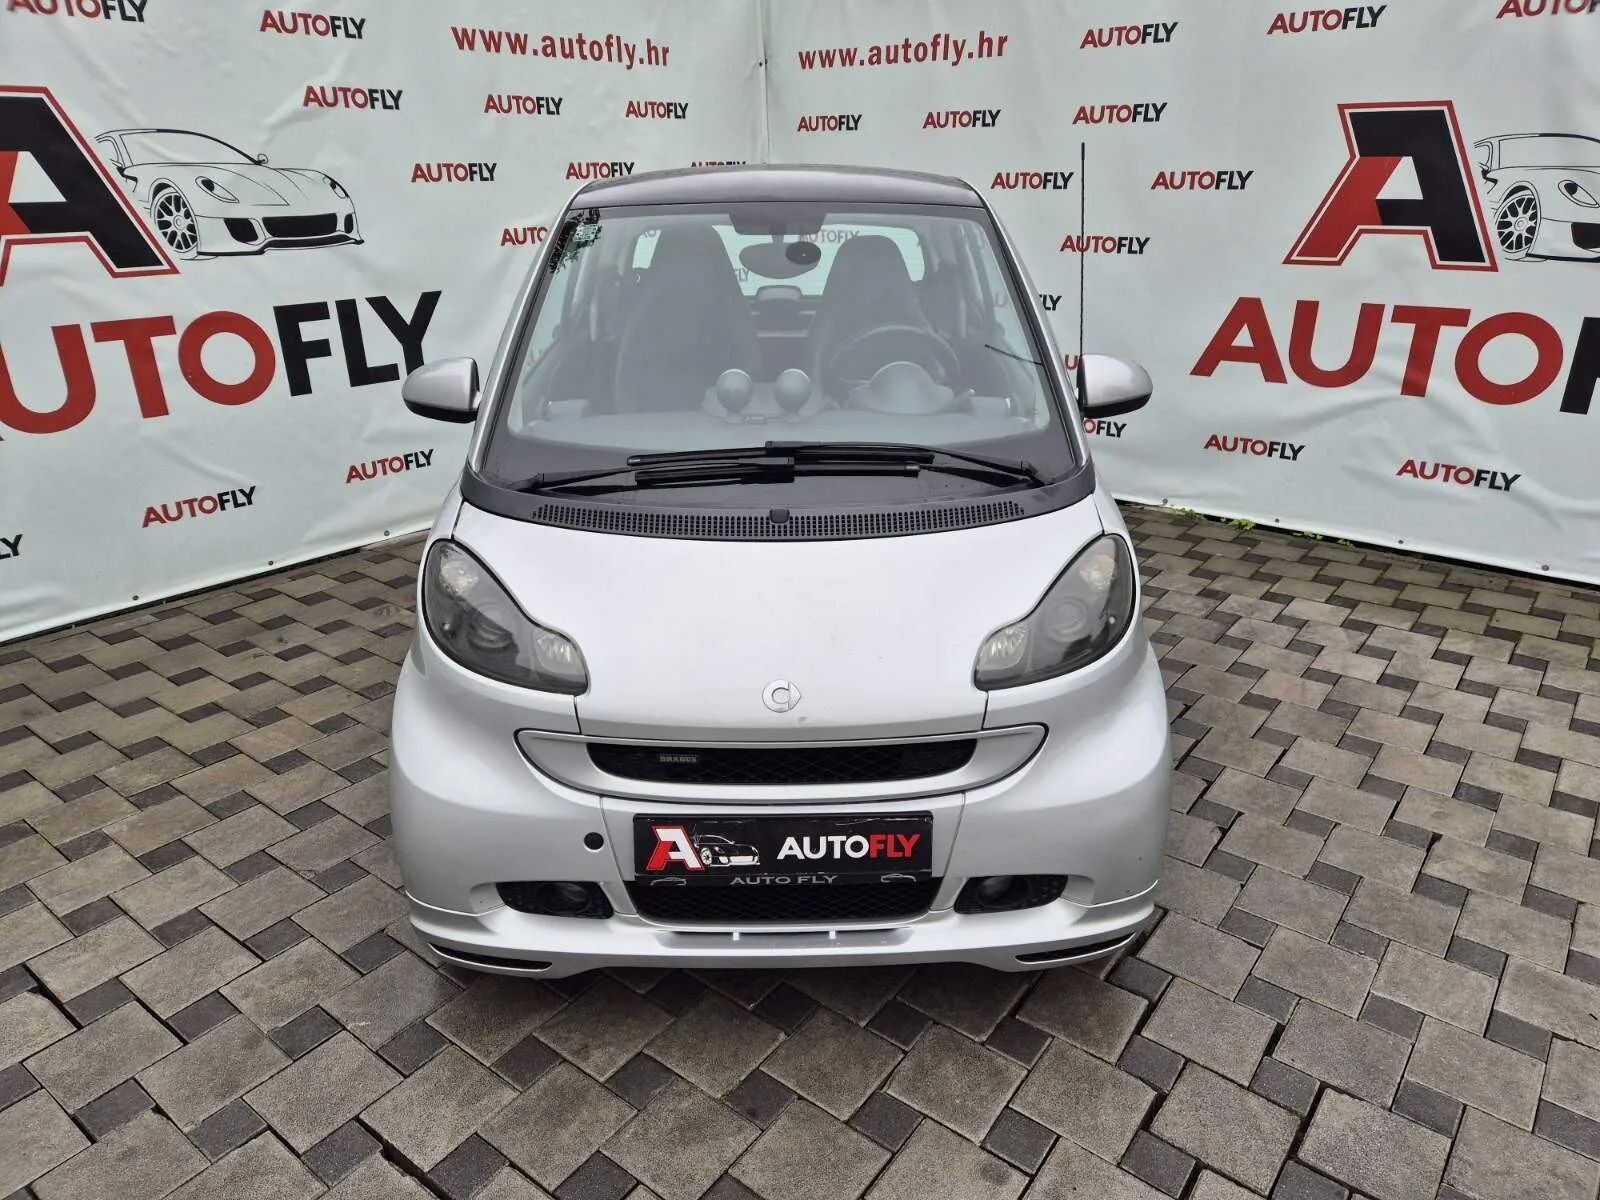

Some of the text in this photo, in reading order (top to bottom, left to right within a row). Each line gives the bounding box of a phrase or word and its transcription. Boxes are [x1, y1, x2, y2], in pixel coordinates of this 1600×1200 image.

[260, 10, 366, 39] AUTOFLY
[1267, 5, 1387, 35] AUTOFLY
[1080, 22, 1178, 49] AUTOFLY
[451, 27, 669, 70] www.autofly.hr
[798, 31, 1008, 70] www.autofly.hr
[303, 86, 403, 110] AUTOFLY
[484, 94, 563, 115] AUTOFLY
[626, 101, 688, 119] AUTOFLY
[797, 114, 862, 132] AUTOFLY
[923, 109, 1001, 129] AUTOFLY
[1072, 102, 1167, 124] AUTOFLY
[411, 163, 497, 183] AUTOFLY
[991, 172, 1074, 190] AUTOFLY
[1151, 171, 1254, 190] AUTOFLY
[1060, 235, 1150, 254] AUTOFLY
[0, 290, 442, 441] UTOFLY
[1204, 434, 1305, 461] AUTOFLY
[346, 449, 434, 484] AUTOFLY
[1396, 460, 1521, 492] AUTOFLY
[142, 486, 256, 528] AUTOFLY
[777, 834, 921, 860] AUTOFLY
[730, 875, 838, 885] AUTO FLY
